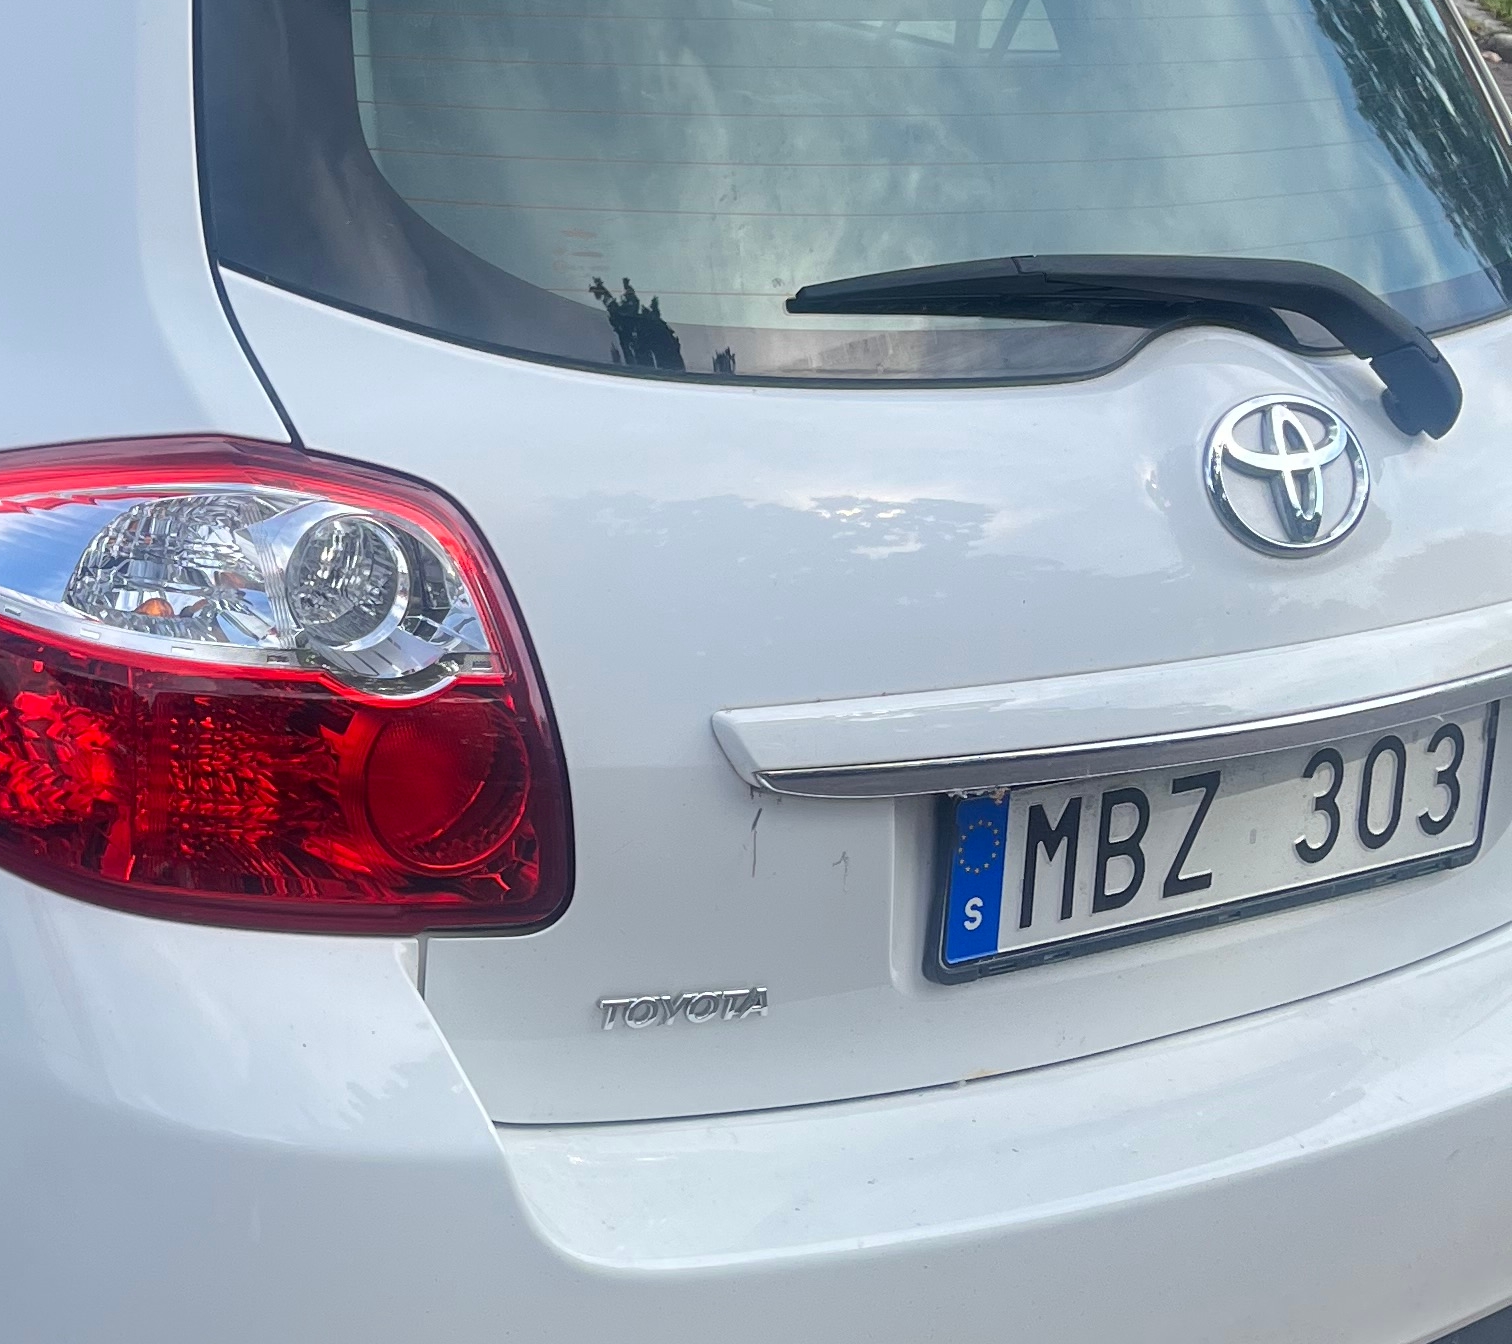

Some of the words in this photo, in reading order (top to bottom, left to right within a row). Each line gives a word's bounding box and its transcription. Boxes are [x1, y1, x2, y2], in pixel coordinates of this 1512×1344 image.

[1018, 770, 1223, 930] MBZ
[1293, 722, 1466, 864] 303
[963, 896, 983, 931] S
[598, 986, 768, 1031] TOYOTA
